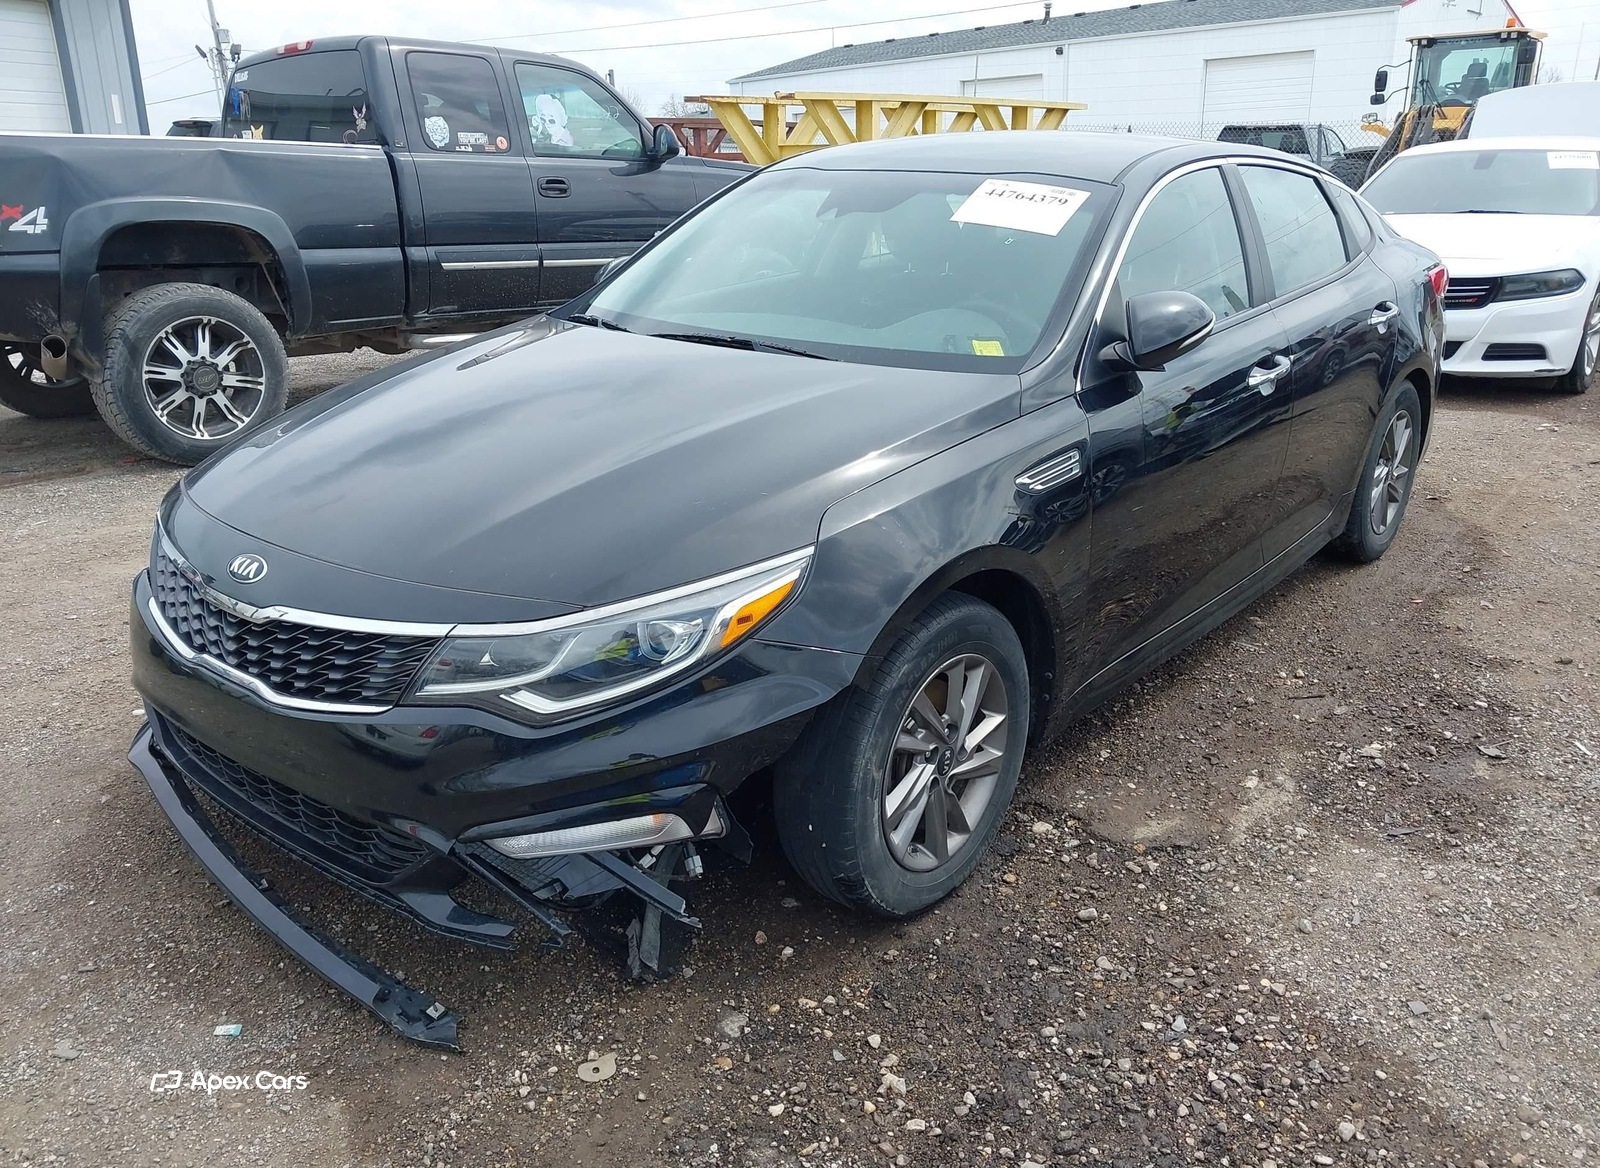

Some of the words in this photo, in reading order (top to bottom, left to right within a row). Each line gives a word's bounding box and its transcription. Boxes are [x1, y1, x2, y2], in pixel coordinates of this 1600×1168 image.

[985, 188, 1069, 206] 44764379
[230, 556, 259, 579] KIA
[942, 750, 951, 774] KIA
